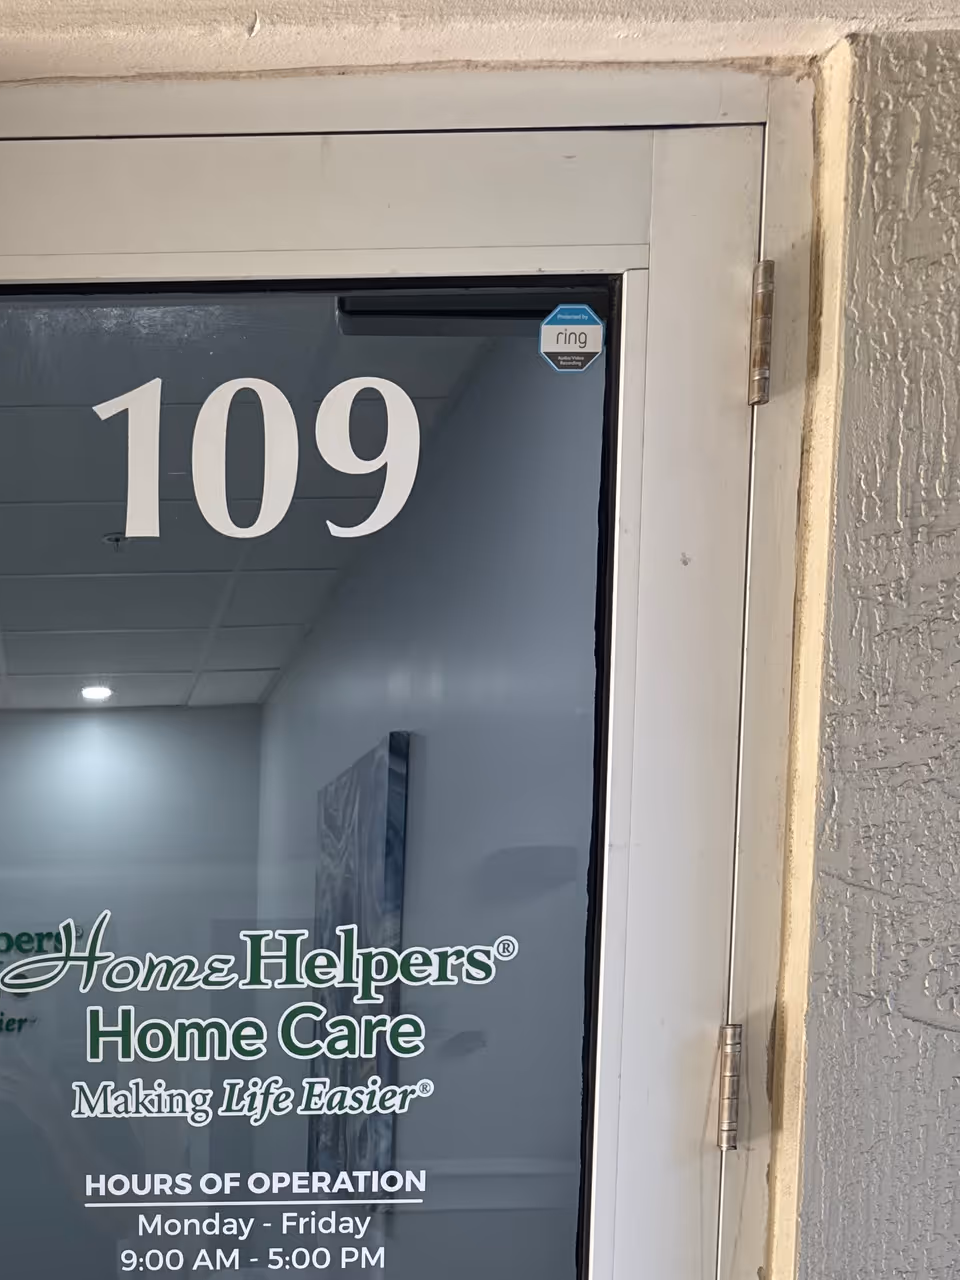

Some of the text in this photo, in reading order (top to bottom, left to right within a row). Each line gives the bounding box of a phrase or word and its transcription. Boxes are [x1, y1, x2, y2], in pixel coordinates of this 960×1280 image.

[556, 328, 588, 349] ring
[92, 376, 421, 538] 109
[86, 1001, 426, 1063] Home Care
[71, 1078, 214, 1128] Making
[217, 1075, 295, 1127] Life
[85, 1169, 427, 1197] HOURS OF OPERATION
[138, 1212, 255, 1241] Monday
[281, 1210, 372, 1240] Friday
[120, 1249, 185, 1272] 9:00
[192, 1248, 241, 1271] AM
[267, 1247, 332, 1271] 5:00
[340, 1246, 386, 1270] PM
